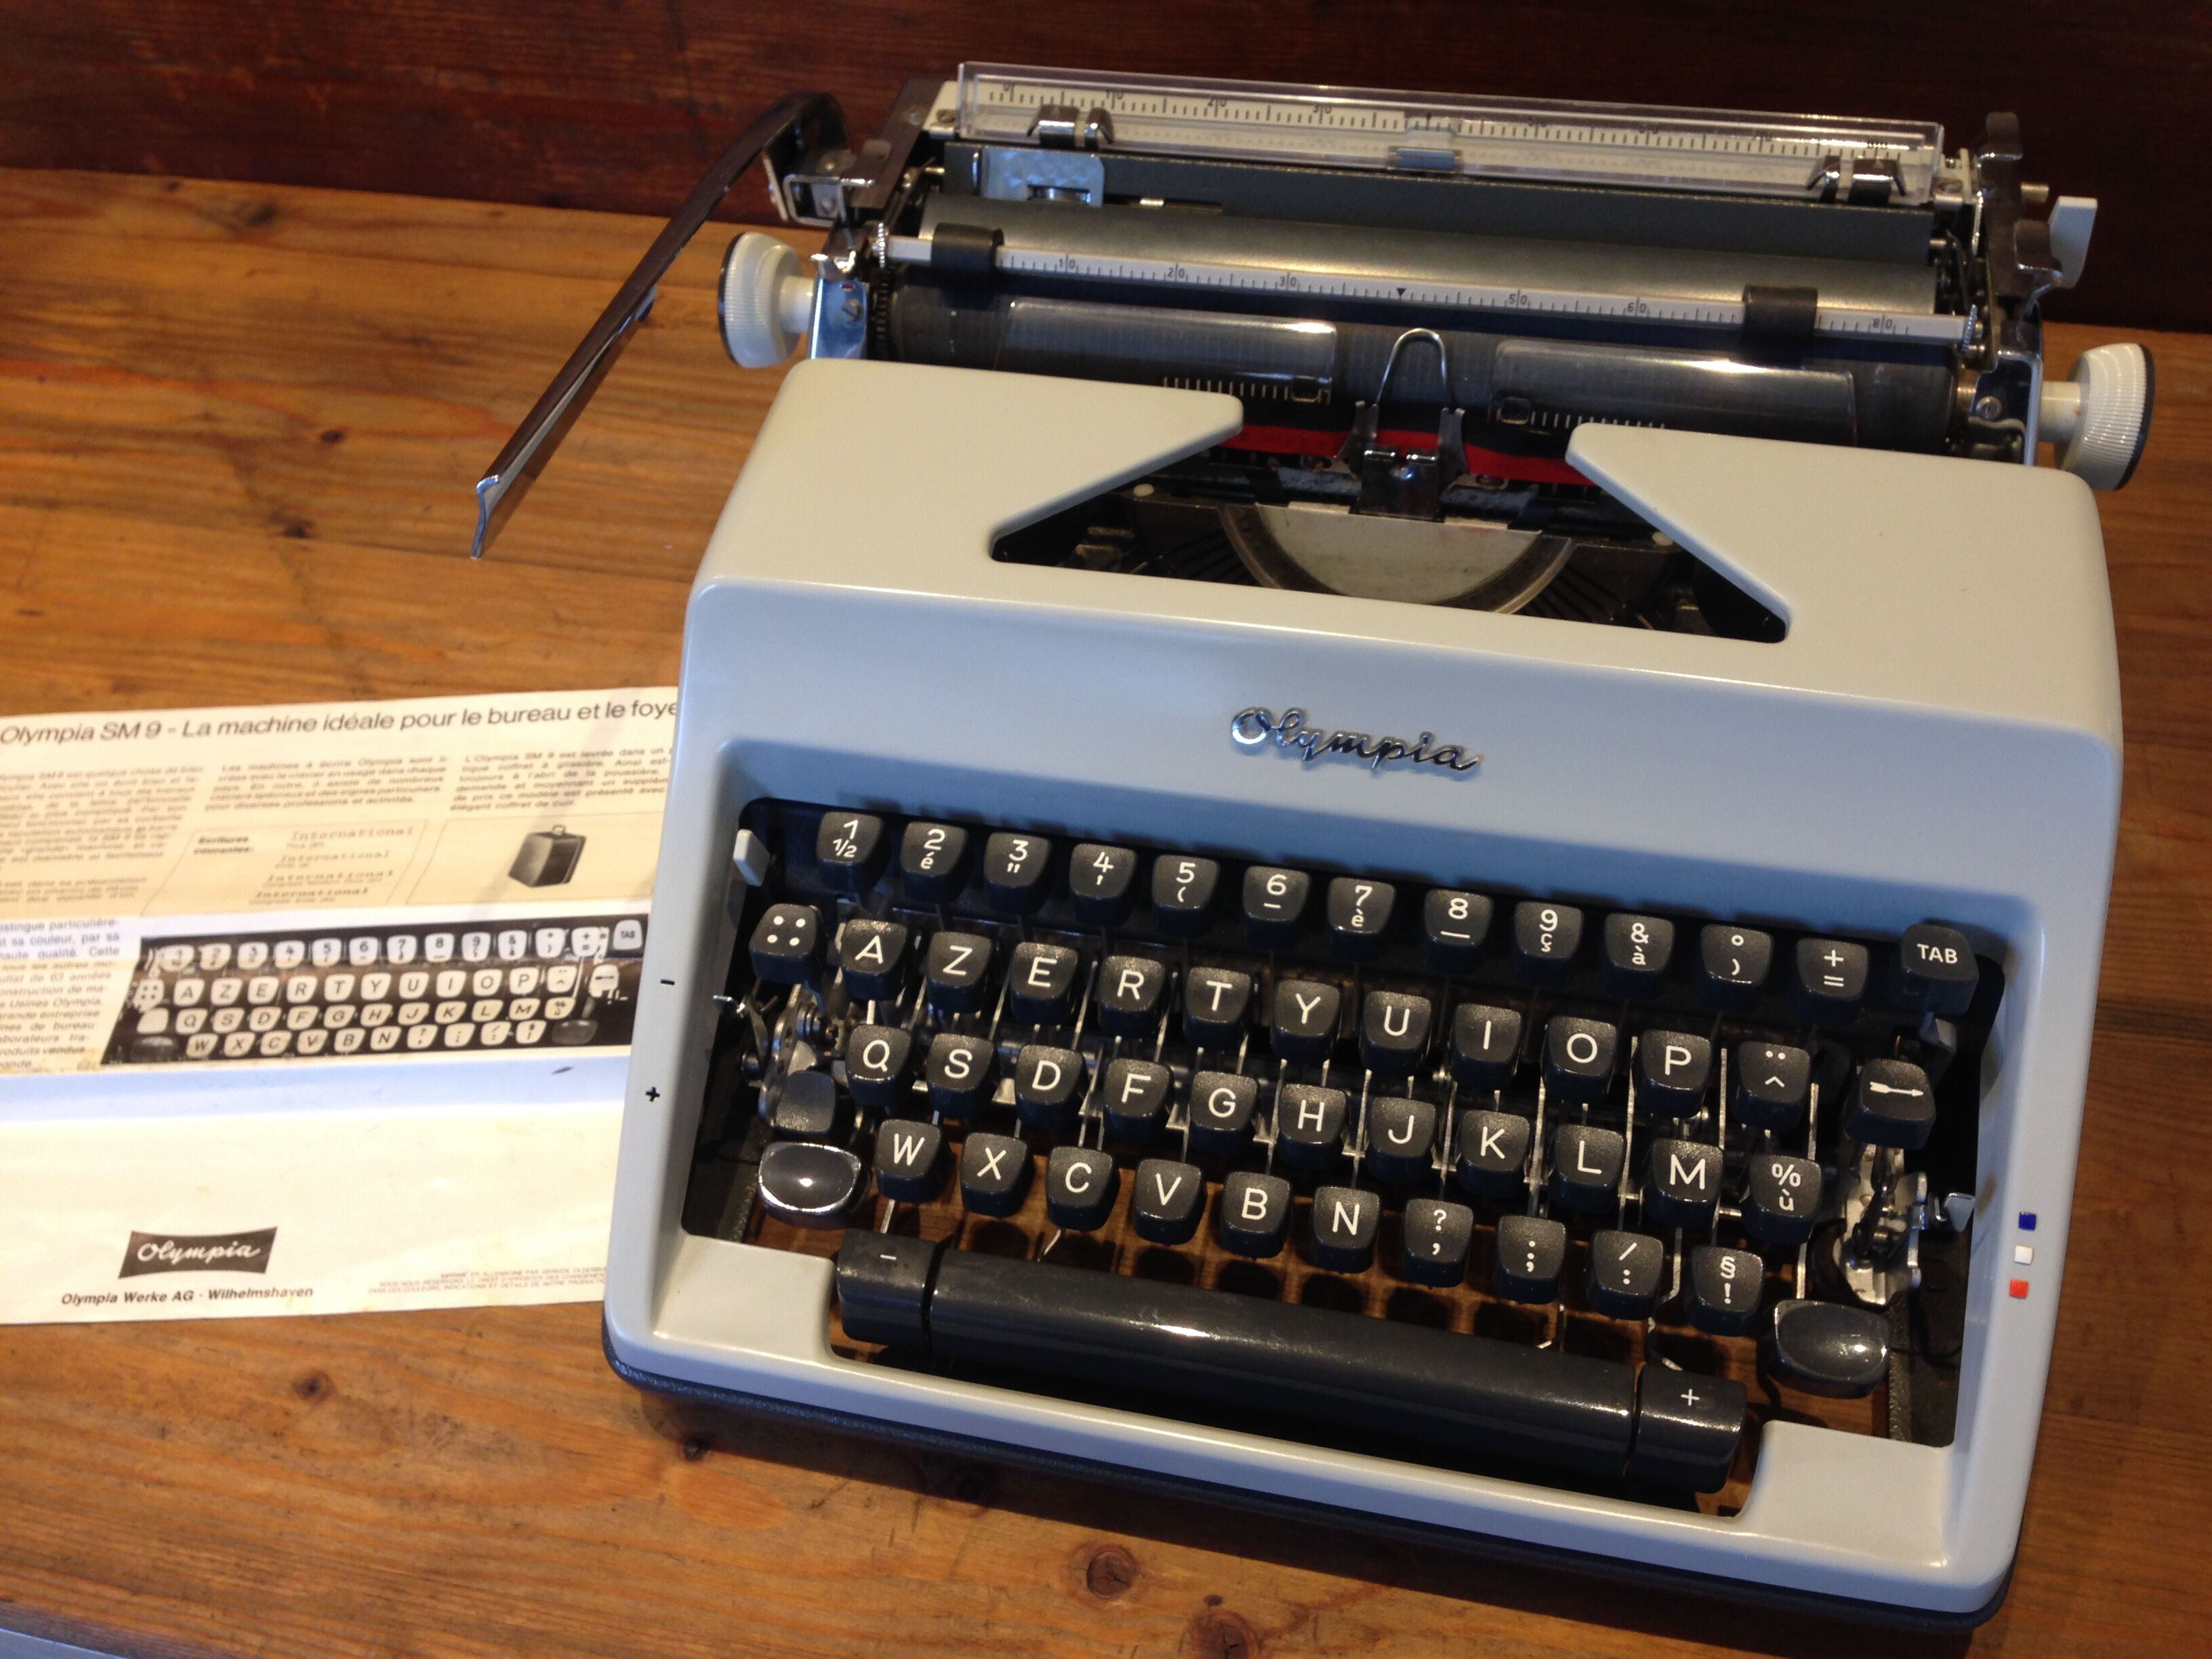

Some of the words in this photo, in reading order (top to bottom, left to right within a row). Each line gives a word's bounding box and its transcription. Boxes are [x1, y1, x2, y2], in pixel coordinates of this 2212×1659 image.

[1058, 258, 1076, 270] 10
[1167, 267, 1185, 278] 20
[1279, 275, 1296, 287] 30
[1509, 293, 1528, 305] 50
[1627, 302, 1647, 313] 60
[1872, 318, 1892, 329] 80
[0, 723, 95, 746] Olympia
[100, 721, 141, 741] SM
[145, 720, 162, 739] 9
[182, 719, 211, 737] La
[218, 715, 317, 735] machine
[322, 711, 394, 731] idéale
[400, 711, 457, 732] pour
[462, 704, 482, 725] le
[487, 701, 571, 724] bureau
[577, 701, 600, 719] et
[605, 700, 626, 718] le
[1231, 706, 1484, 771] Olympia
[920, 851, 935, 869] é
[844, 819, 859, 840] 1
[924, 828, 946, 851] 2
[1008, 839, 1029, 861] 3
[1093, 851, 1114, 873] 4
[1176, 861, 1196, 884] 5
[1267, 874, 1288, 896] 6
[1354, 884, 1373, 907] 7
[1448, 897, 1469, 920] 8
[1539, 908, 1559, 933] 9
[1631, 922, 1650, 944] &
[1824, 949, 1844, 967] +
[1917, 943, 1959, 965] TAB
[619, 930, 636, 940] TAB
[180, 985, 194, 1000] A
[218, 983, 232, 1000] Z
[255, 982, 270, 998] E
[295, 981, 308, 996] R
[333, 979, 346, 995] T
[370, 979, 383, 993] Y
[407, 977, 420, 991] U
[447, 977, 453, 989] I
[480, 975, 495, 989] O
[517, 973, 531, 988] P
[183, 1015, 198, 1029] Q
[220, 1012, 234, 1027] S
[257, 1010, 271, 1025] D
[295, 1010, 309, 1025] F
[331, 1010, 346, 1023] G
[369, 1007, 383, 1019] H
[407, 1006, 419, 1019] J
[442, 1005, 457, 1018] K
[480, 1005, 491, 1017] L
[515, 1004, 533, 1015] M
[855, 934, 884, 964] A
[943, 945, 974, 976] Z
[1027, 956, 1058, 987] E
[1116, 968, 1145, 1000] R
[1206, 979, 1233, 1011] T
[1294, 992, 1322, 1025] Y
[1383, 1005, 1410, 1037] U
[1482, 1019, 1492, 1050] I
[1565, 1032, 1599, 1064] O
[1664, 1044, 1692, 1076] P
[194, 1038, 210, 1052] W
[232, 1038, 246, 1051] X
[268, 1036, 282, 1050] C
[306, 1034, 320, 1048] V
[342, 1033, 354, 1047] B
[377, 1031, 393, 1045] N
[861, 1038, 890, 1073] Q
[943, 1048, 973, 1079] S
[1031, 1059, 1062, 1091] D
[1121, 1072, 1152, 1103] F
[1207, 1086, 1237, 1118] G
[1297, 1098, 1326, 1132] H
[1387, 1113, 1415, 1145] J
[1479, 1125, 1507, 1160] K
[1576, 1139, 1603, 1176] L
[1668, 1153, 1707, 1191] M
[1771, 1162, 1801, 1188] %
[893, 1132, 926, 1166] W
[976, 1146, 1008, 1181] X
[1063, 1161, 1093, 1194] C
[1154, 1172, 1183, 1206] V
[1240, 1187, 1269, 1221] B
[1331, 1200, 1361, 1237] N
[1432, 1208, 1448, 1233] ?
[137, 1239, 262, 1266] Olympia
[1719, 1255, 1736, 1279] §
[62, 1292, 118, 1307] Olympia
[123, 1290, 167, 1303] Werke
[171, 1290, 194, 1302] AG
[208, 1286, 314, 1301] Wilhelmshaven
